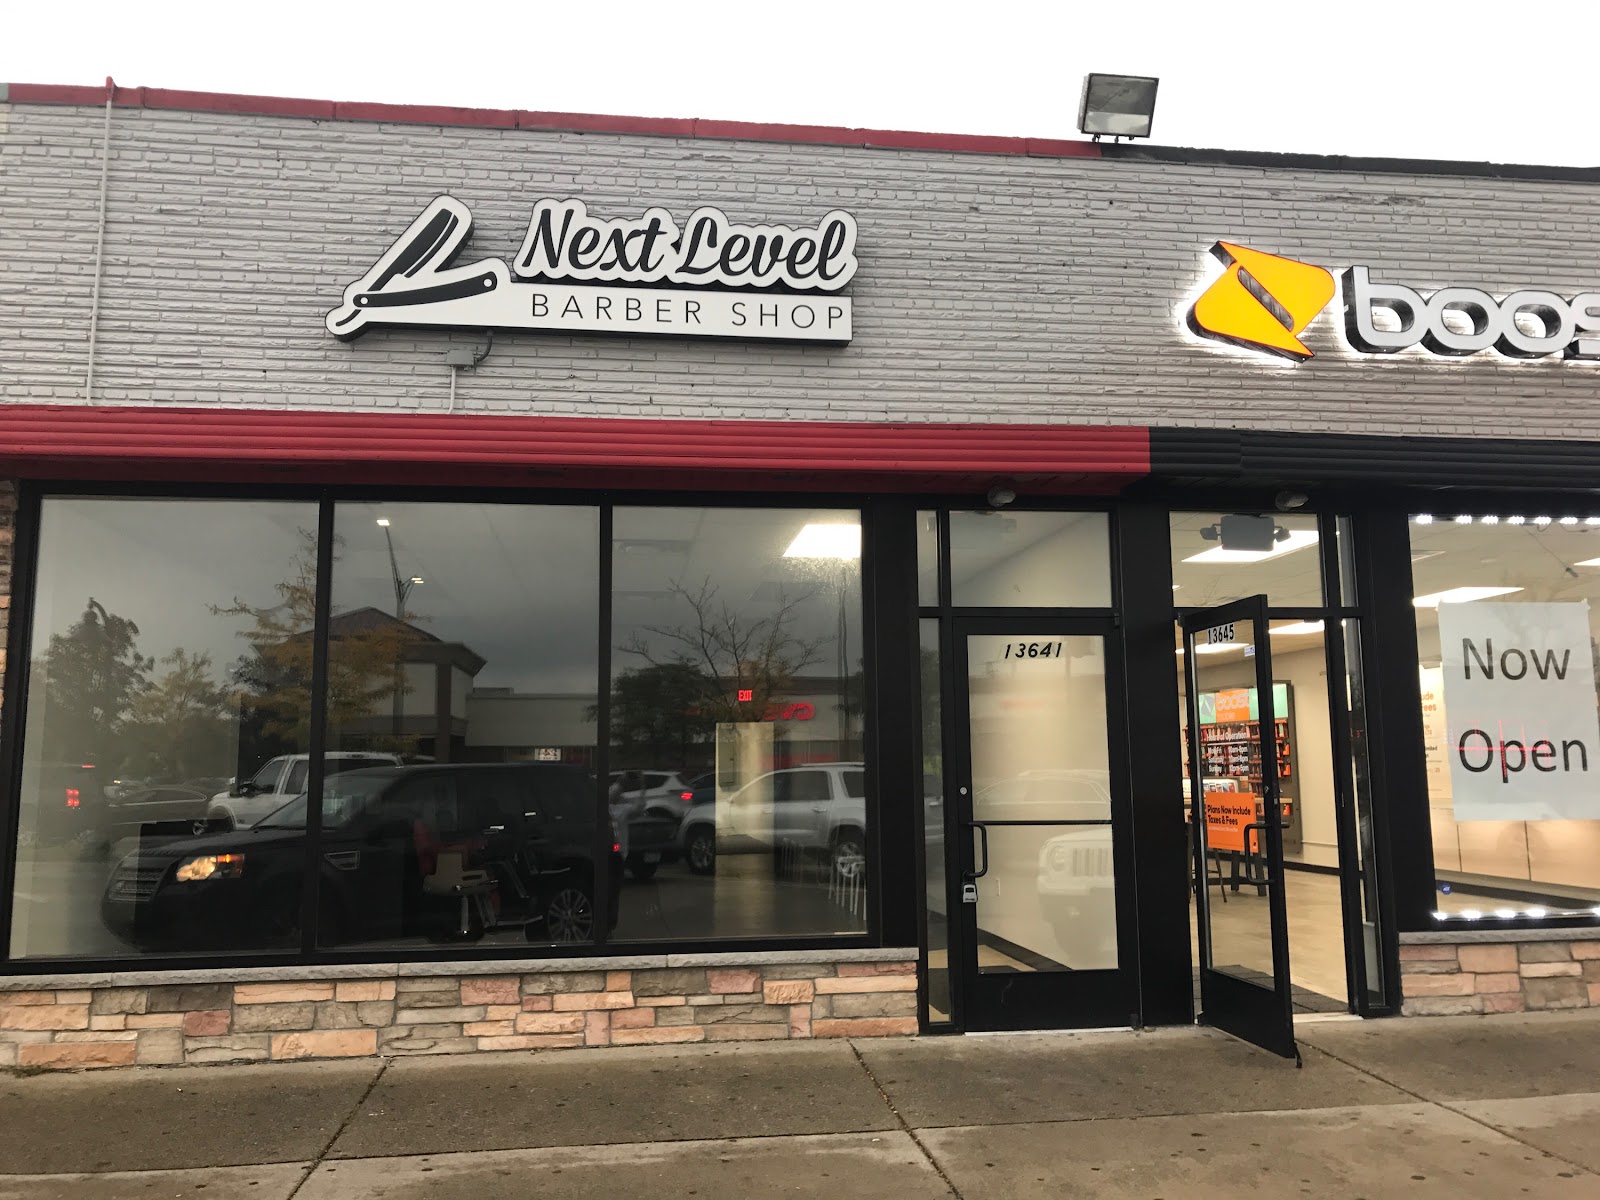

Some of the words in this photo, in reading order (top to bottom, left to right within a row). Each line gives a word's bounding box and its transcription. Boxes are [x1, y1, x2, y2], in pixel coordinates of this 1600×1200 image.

[522, 208, 668, 272] Next
[676, 216, 847, 280] Level
[532, 293, 702, 325] BARBER
[730, 301, 845, 330] SHOP
[1208, 624, 1234, 645] 13645
[1004, 642, 1062, 660] 13641
[1462, 637, 1571, 681] Now
[738, 690, 753, 701] EXIT
[1225, 732, 1247, 742] Operation
[1459, 728, 1588, 784] Open
[1207, 804, 1220, 814] Plans
[1221, 805, 1232, 814] Now
[1232, 805, 1251, 815] Include
[1207, 815, 1220, 824] Taxes
[1221, 815, 1225, 824] &
[1226, 816, 1238, 825] Fees
